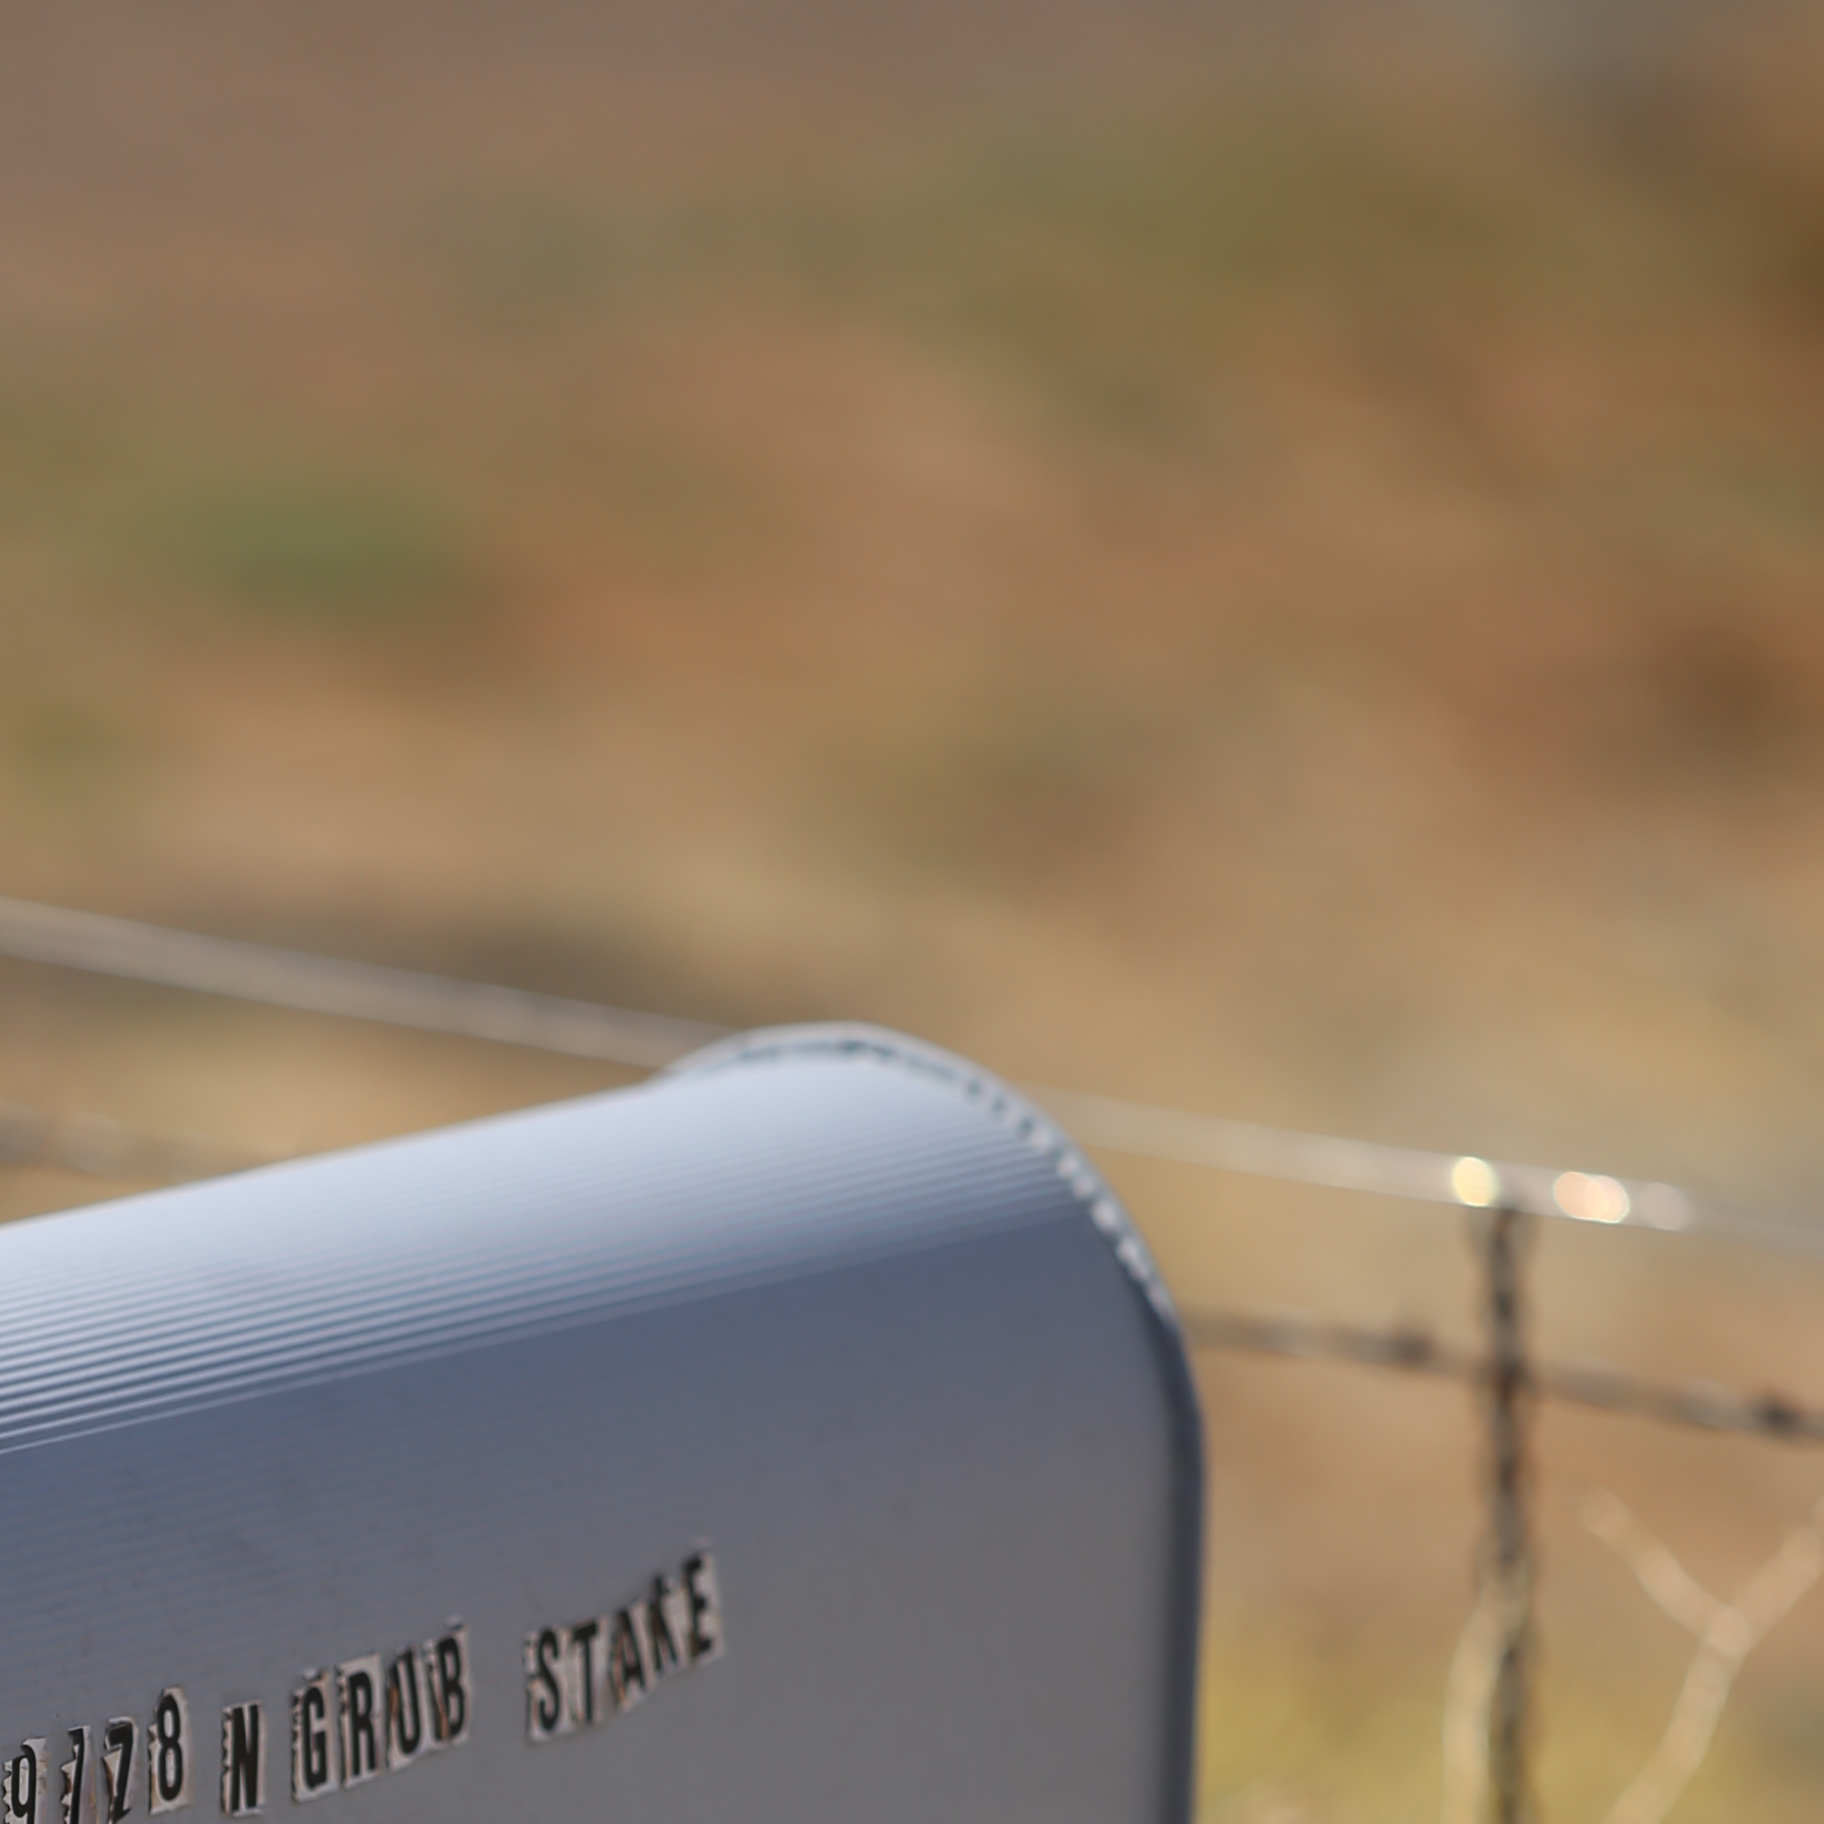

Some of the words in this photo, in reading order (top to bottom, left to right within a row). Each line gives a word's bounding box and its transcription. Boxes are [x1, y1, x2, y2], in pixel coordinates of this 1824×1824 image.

[229, 1703, 259, 1812] N
[302, 1637, 465, 1790] GRUB
[537, 1553, 711, 1731] STAKE
